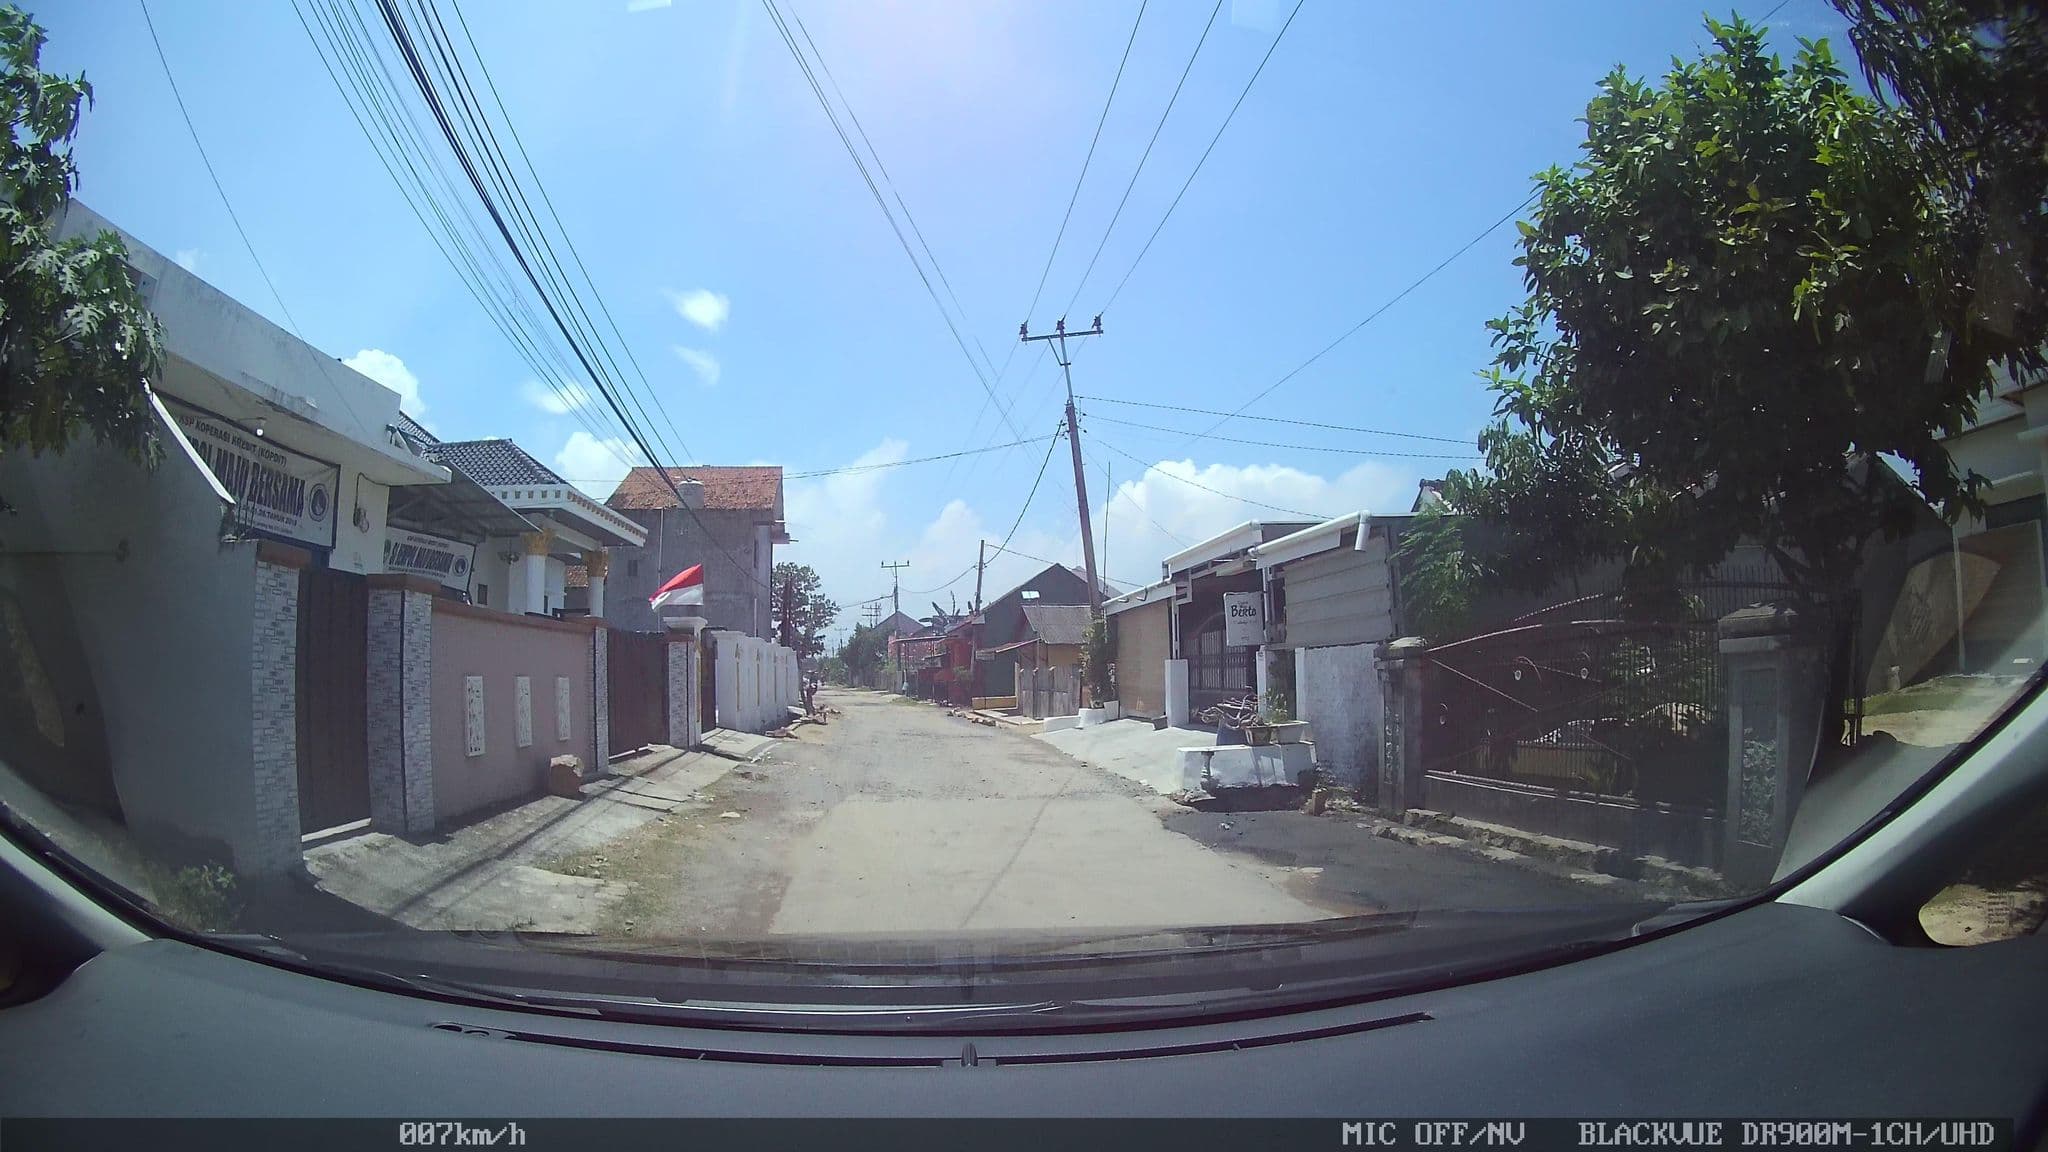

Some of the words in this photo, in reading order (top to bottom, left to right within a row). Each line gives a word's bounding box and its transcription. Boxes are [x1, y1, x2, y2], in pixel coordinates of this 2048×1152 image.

[195, 418, 230, 443] KOPERASI
[231, 434, 256, 454] KREDIT
[257, 447, 287, 468] (KOPDIT)
[248, 462, 305, 518] BERSAMA
